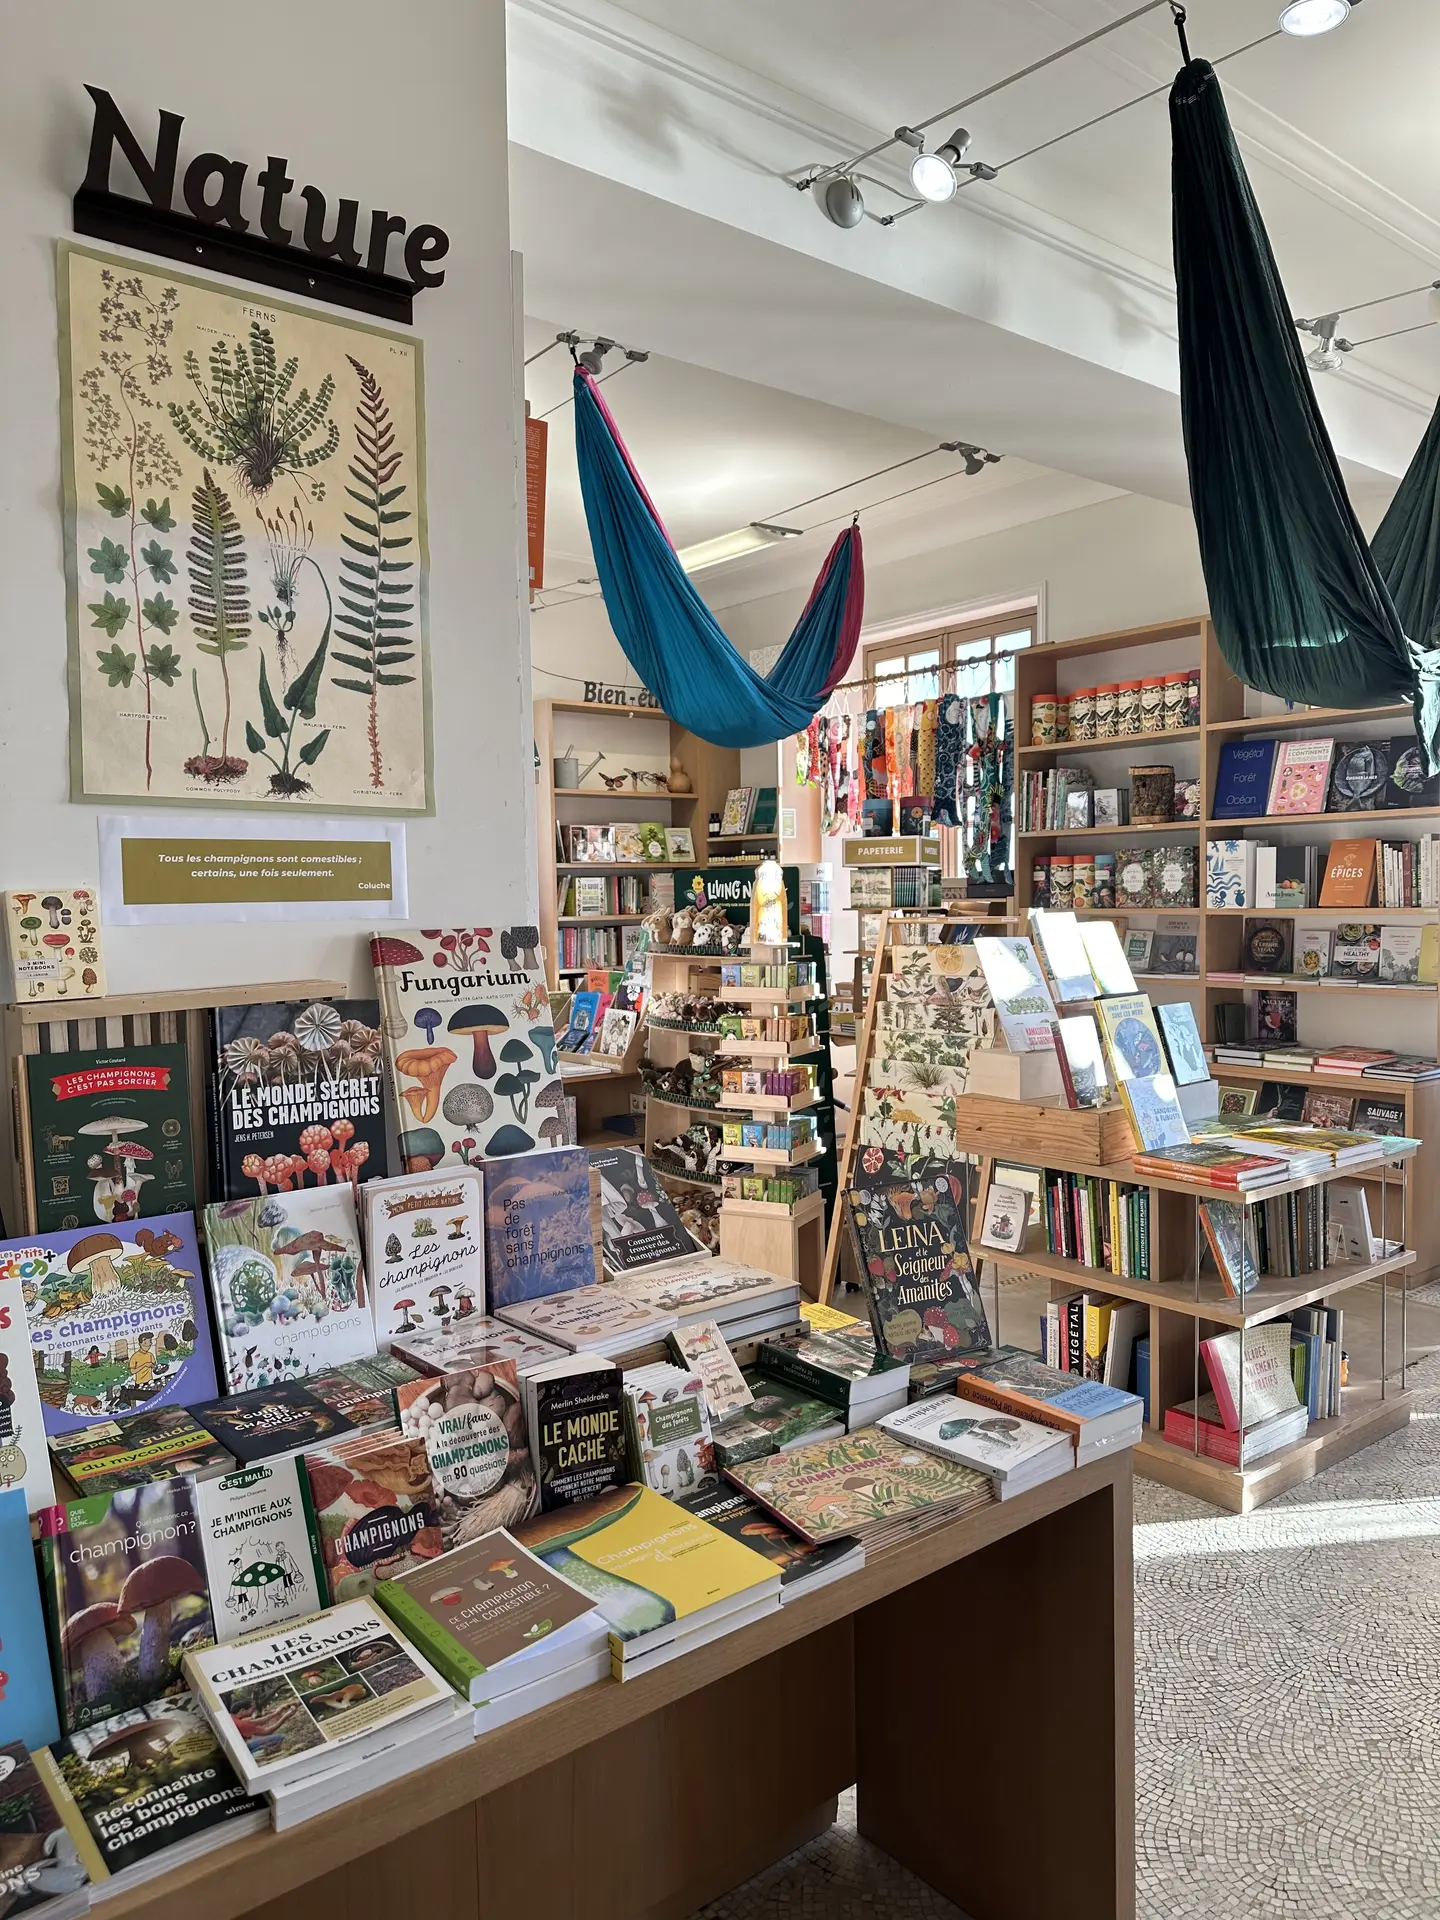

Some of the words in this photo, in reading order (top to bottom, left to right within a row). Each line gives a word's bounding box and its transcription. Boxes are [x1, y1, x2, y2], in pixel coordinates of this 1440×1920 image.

[83, 83, 450, 288] Nature
[242, 306, 277, 323] FERNS
[1232, 748, 1264, 761] Végétal
[1291, 749, 1330, 757] CONTINENTS
[1233, 772, 1257, 783] Forêt
[1226, 794, 1257, 805] Océan
[158, 854, 184, 863] Tous
[186, 854, 202, 863] les
[204, 854, 275, 864] champignons
[276, 855, 299, 863] sont
[300, 855, 357, 863] comestibles
[857, 846, 904, 856] PAPETERIE
[191, 869, 236, 878] certains,
[239, 870, 258, 878] une
[261, 868, 280, 877] fois
[281, 869, 335, 877] seulement.
[1330, 867, 1364, 879] ÉPICES
[1280, 891, 1296, 899] Jones
[400, 969, 531, 996] Fungarium
[66, 1075, 84, 1086] LES
[86, 1070, 156, 1081] CHAMPIGNONS
[67, 1082, 93, 1094] C'EST
[97, 1079, 115, 1087] PAS
[117, 1077, 157, 1087] SORCIER
[232, 1088, 250, 1110] LE
[256, 1083, 315, 1108] MONDE
[320, 1076, 379, 1099] SECRET
[232, 1107, 264, 1130] DES
[268, 1096, 380, 1126] CHAMPIGNONS
[1316, 1100, 1341, 1108] Brunch
[1367, 1107, 1399, 1119] SAUVAGE
[234, 1132, 247, 1143] JENS
[251, 1131, 275, 1141] PETERSEN
[392, 1204, 404, 1215] MON
[407, 1199, 423, 1211] PETIT
[423, 1198, 440, 1209] GUIDE
[440, 1196, 460, 1206] NATURE
[503, 1198, 526, 1212] Pas
[504, 1212, 520, 1226] de
[505, 1225, 536, 1240] forêt
[627, 1233, 665, 1247] Comment
[878, 1220, 946, 1253] LEINA
[14, 1249, 44, 1262] p'tits
[408, 1241, 441, 1260] Les
[506, 1240, 535, 1255] sans
[626, 1244, 677, 1263] champignons
[629, 1243, 657, 1254] trouver
[657, 1239, 670, 1249] des
[379, 1244, 480, 1290] champignons
[894, 1251, 948, 1282] Seigneur
[919, 1273, 930, 1284] des
[897, 1278, 953, 1306] Amanites
[59, 1302, 185, 1339] champignons
[556, 1305, 622, 1326] champignons
[48, 1334, 105, 1351] D'étonnants
[106, 1328, 130, 1342] êtres
[131, 1321, 164, 1336] vivants
[274, 1315, 361, 1348] champignons
[1069, 1305, 1081, 1365] VÉGÉTAL
[1089, 1312, 1098, 1353] OISEAUX
[423, 1328, 515, 1358] CHAMPIGNONS
[322, 1387, 364, 1404] Aller
[550, 1398, 574, 1411] Merlin
[574, 1392, 610, 1406] Sheldrake
[971, 1390, 1002, 1409] Provence
[1062, 1387, 1121, 1411] Provence
[243, 1404, 287, 1419] GUIDE
[655, 1407, 694, 1424] Champignons
[438, 1412, 492, 1435] VRAI/faux
[543, 1422, 563, 1447] LE
[566, 1410, 619, 1438] MONDE
[661, 1420, 672, 1429] des
[672, 1416, 690, 1428] forêts
[68, 1443, 86, 1453] Le
[88, 1435, 124, 1449] petit
[138, 1424, 196, 1447] guide
[441, 1437, 449, 1448] la
[449, 1429, 488, 1446] découverte
[488, 1425, 501, 1437] des
[82, 1460, 105, 1472] du
[109, 1433, 207, 1465] mycologue
[431, 1436, 509, 1470] CHAMPIGNONS
[558, 1434, 606, 1469] CACHÉ
[219, 1474, 246, 1491] C'EST
[245, 1468, 273, 1485] MALIN
[442, 1472, 453, 1484] en
[453, 1465, 468, 1480] 80
[469, 1458, 507, 1477] questions
[550, 1476, 572, 1488] COMMENT
[573, 1473, 582, 1482] LES
[582, 1466, 616, 1481] CHAMPIGNONS
[787, 1453, 893, 1490] CHAMPIGNONS
[554, 1481, 580, 1494] FAÇONNENT
[580, 1478, 594, 1490] NOTRE
[595, 1474, 612, 1487] MONDE
[564, 1490, 572, 1499] ET
[572, 1483, 602, 1498] INFLUENCENT
[70, 1508, 86, 1517] QUEL
[70, 1515, 81, 1523] EST
[210, 1517, 223, 1528] JE
[224, 1505, 268, 1526] M'INITIE
[269, 1496, 293, 1514] AUX
[212, 1508, 293, 1540] CHAMPIGNONS
[335, 1512, 425, 1556] CHAMPIGNONS
[69, 1520, 197, 1564] champignon?
[597, 1523, 698, 1565] Champignons
[448, 1615, 461, 1626] CE
[460, 1580, 537, 1620] CHAMPIGNON
[455, 1616, 482, 1632] EST-IL
[481, 1588, 544, 1621] COMESTIBLE
[211, 1619, 382, 1684] CHAMPIGNONS
[269, 1632, 313, 1654] LES
[92, 1766, 217, 1827] Reconnaître
[225, 1799, 257, 1815] ulmer
[100, 1818, 134, 1841] les
[137, 1791, 189, 1822] bons
[106, 1785, 248, 1851] champignons
